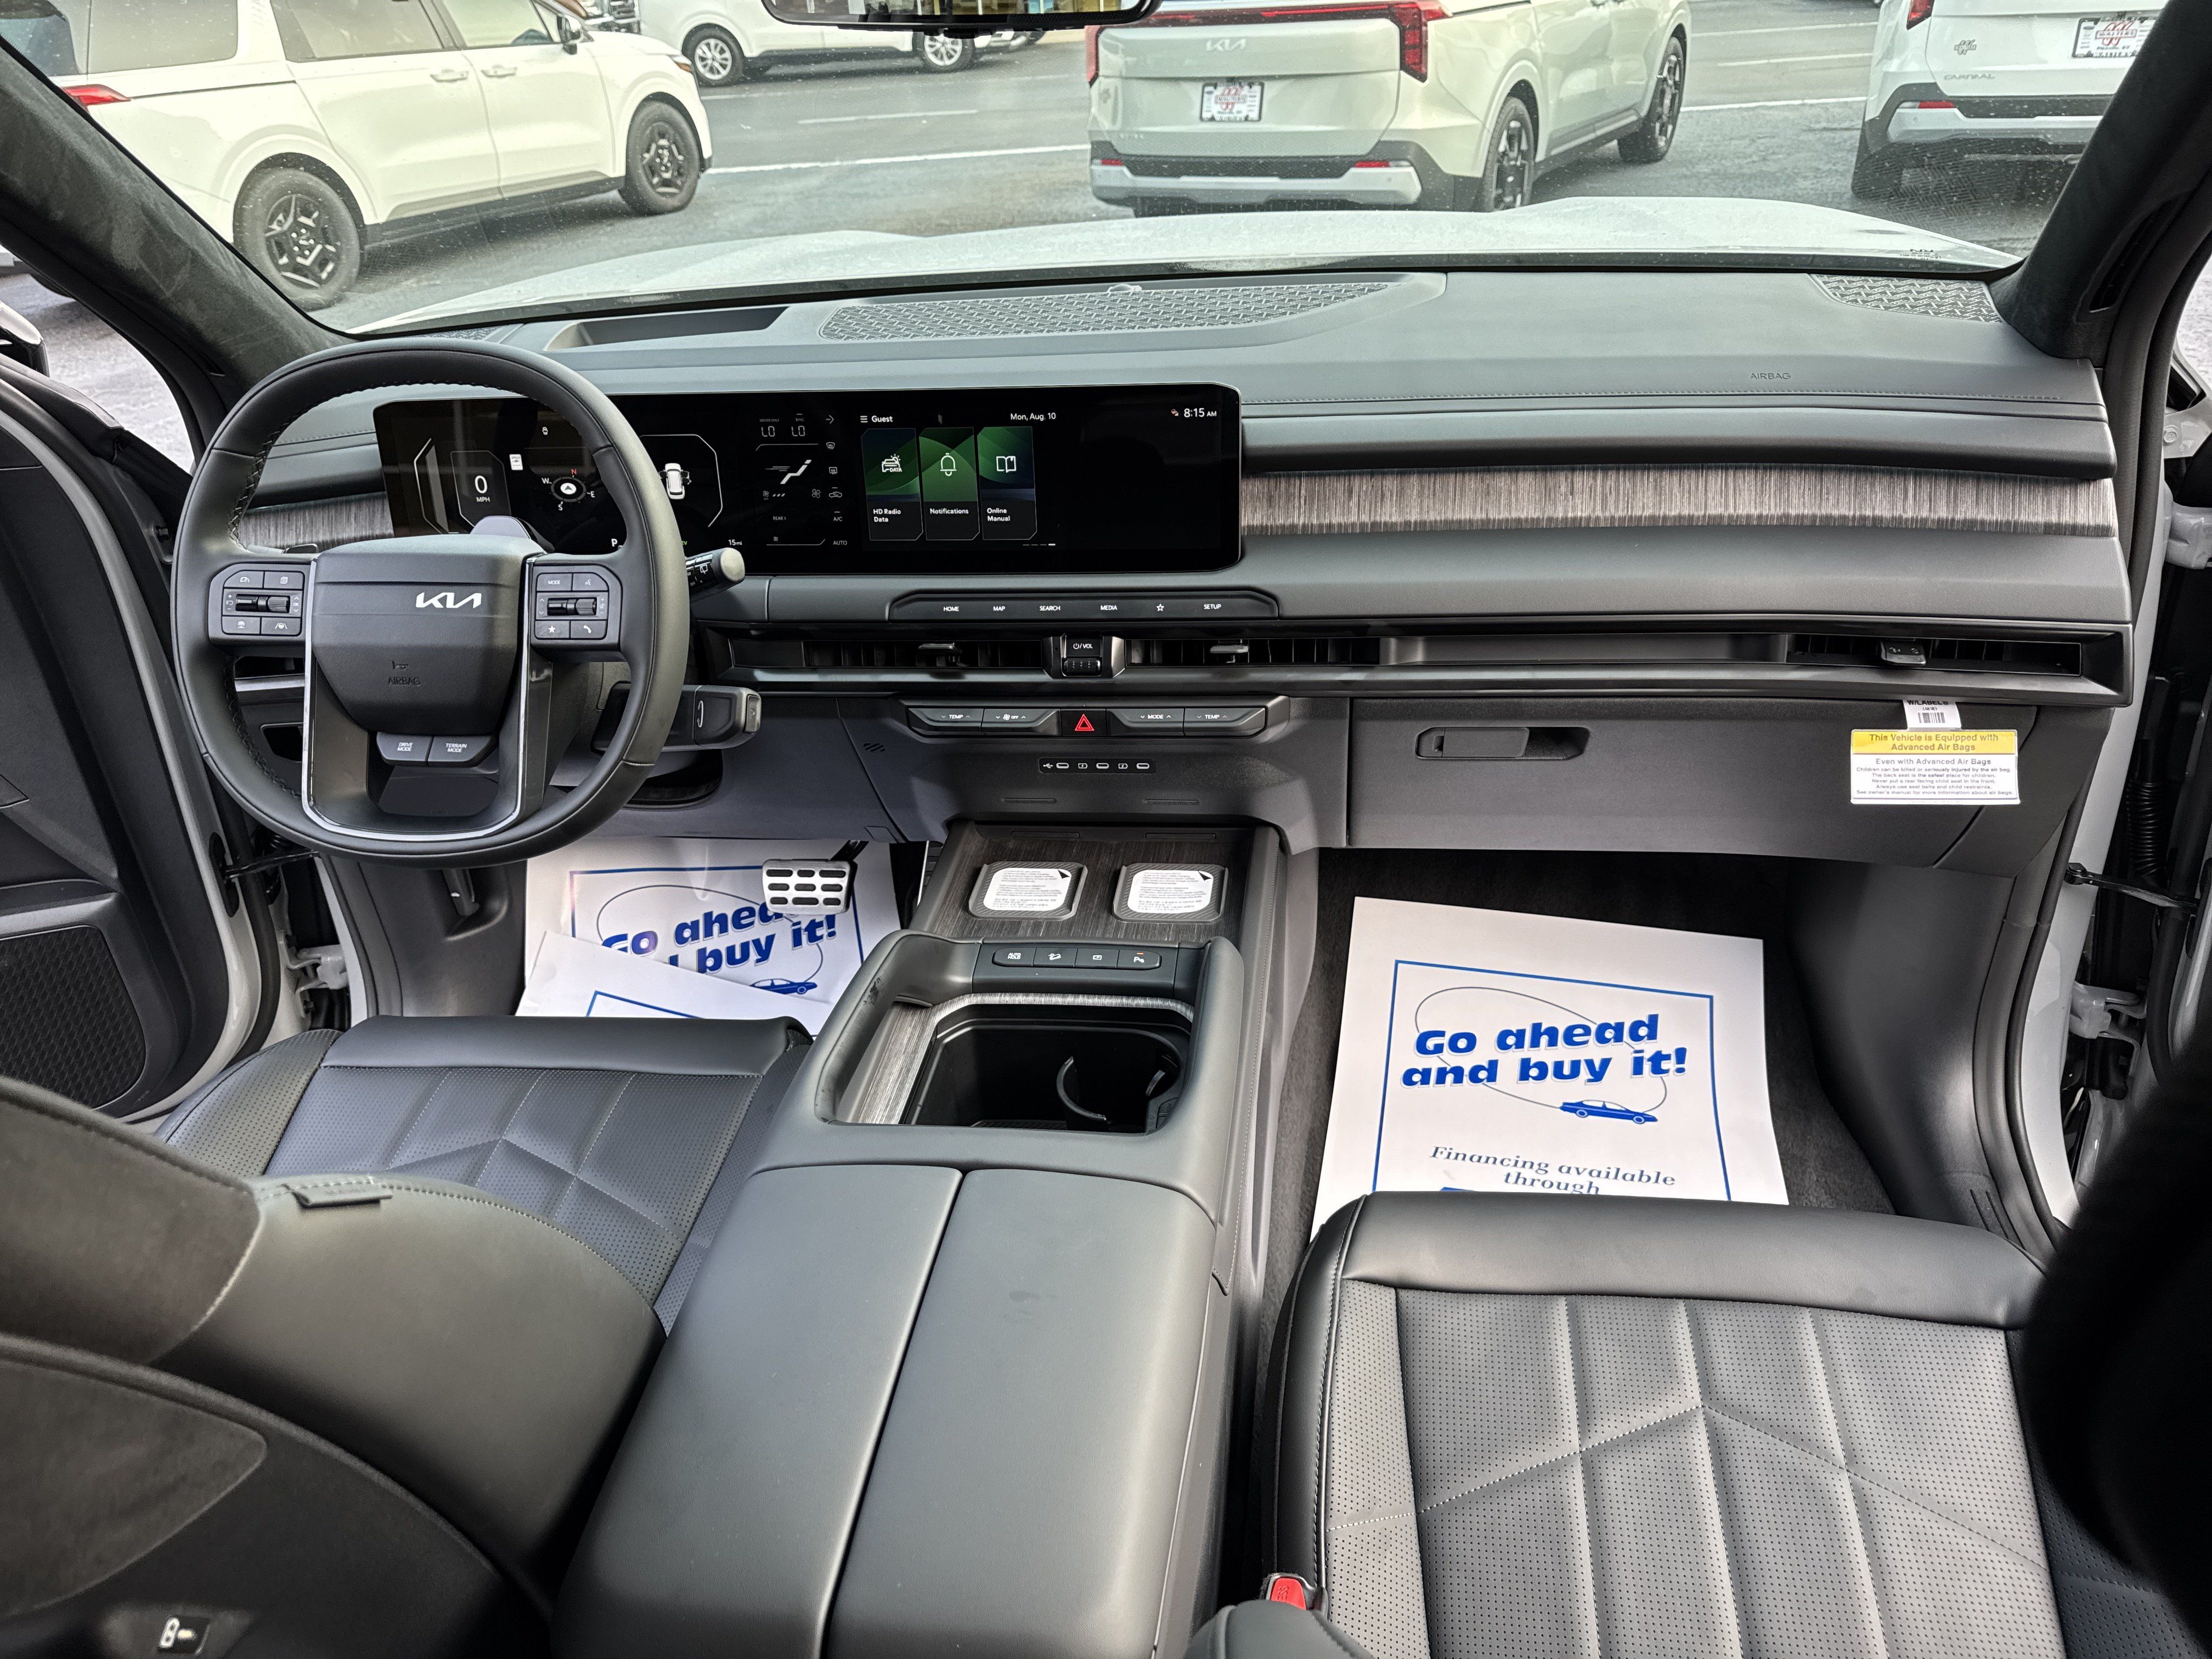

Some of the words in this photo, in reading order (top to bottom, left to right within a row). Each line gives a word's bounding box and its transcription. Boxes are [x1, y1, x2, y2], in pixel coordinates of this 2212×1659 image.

[1010, 413, 1028, 421] Mon,
[1029, 413, 1046, 421] Aug.
[1183, 408, 1205, 417] 8:15
[475, 475, 488, 494] 0
[611, 539, 618, 547] P
[416, 592, 482, 609] KIA
[388, 676, 421, 686] AIRBAG
[1935, 734, 1977, 742] Equipped
[1953, 743, 1976, 752] Bags
[674, 901, 795, 947] ahea
[697, 933, 776, 975] buy
[791, 914, 837, 950] it!
[1415, 1030, 1477, 1056] Go
[1495, 1013, 1660, 1052] ahead
[1401, 1059, 1499, 1088] and
[1516, 1057, 1613, 1085] buy
[1630, 1047, 1688, 1078] it!
[1429, 1146, 1550, 1175] Financing
[1558, 1164, 1677, 1186] available
[1503, 1171, 1601, 1195] through
